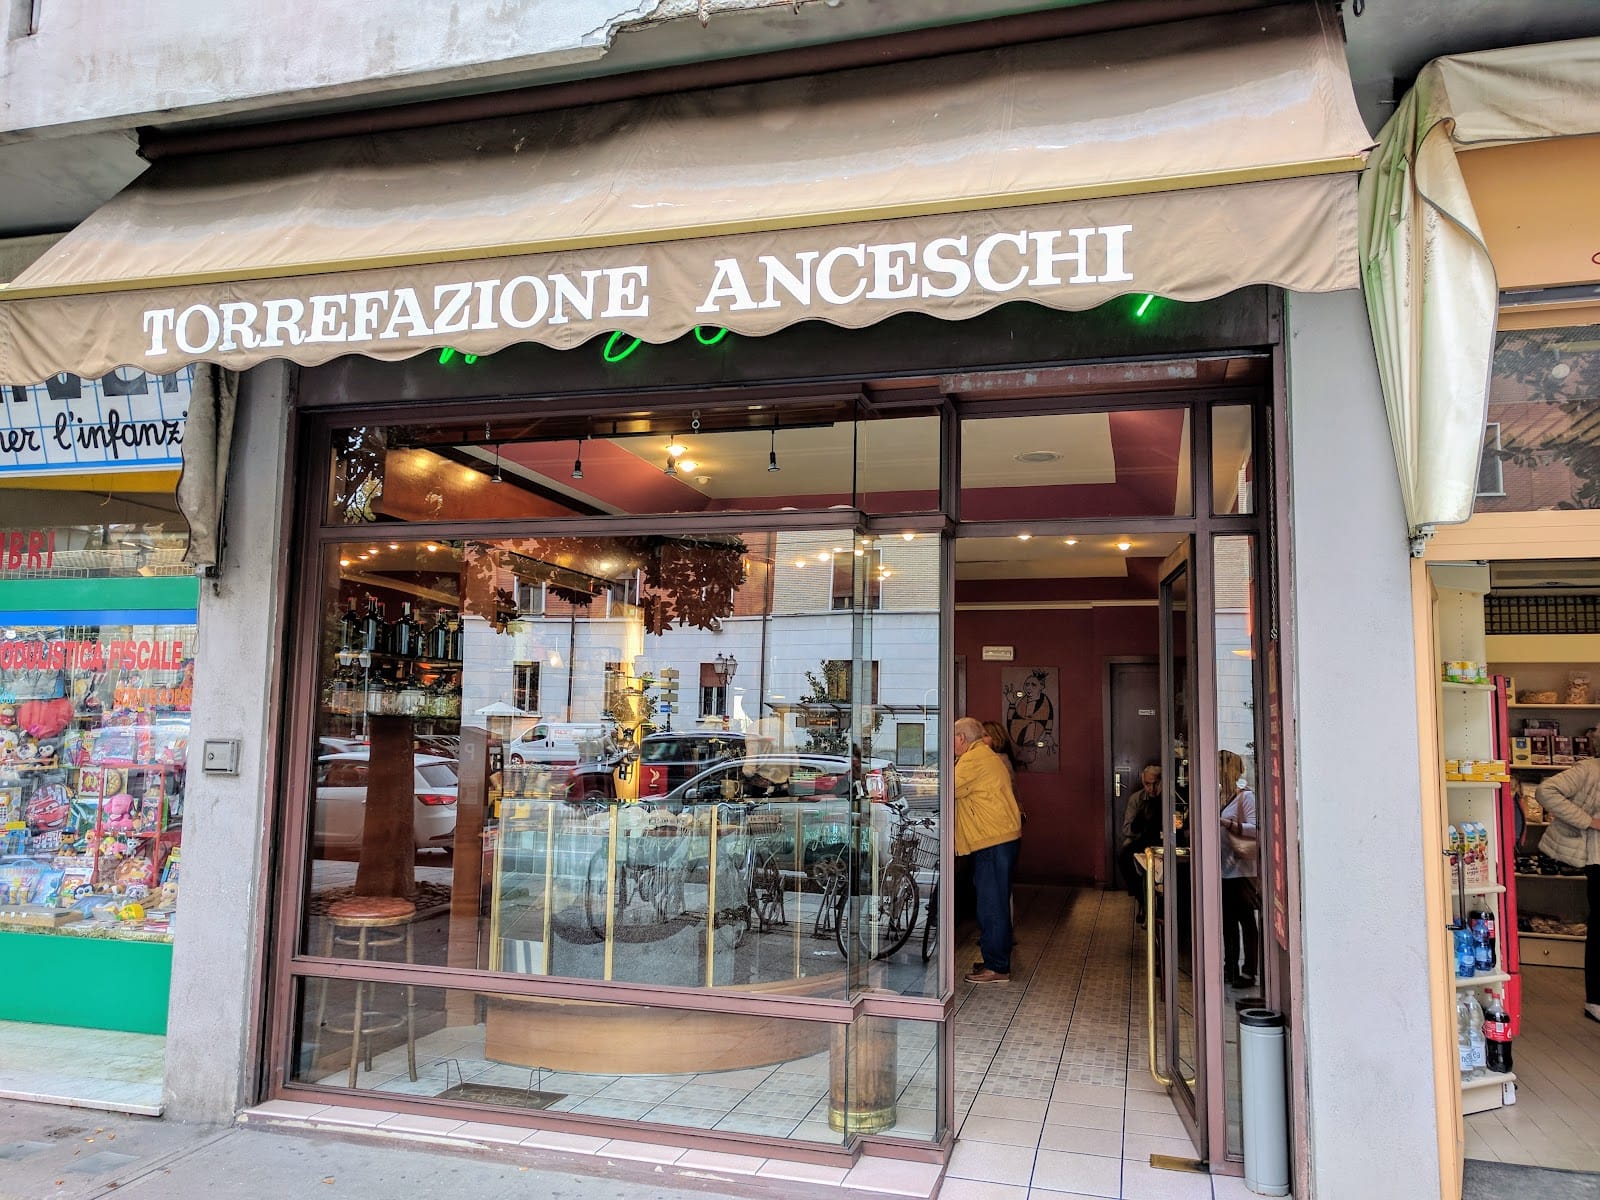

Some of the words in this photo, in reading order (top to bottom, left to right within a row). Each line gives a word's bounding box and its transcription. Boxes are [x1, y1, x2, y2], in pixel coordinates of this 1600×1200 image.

[143, 265, 649, 356] TORREFAZIONE
[695, 224, 1134, 313] ANCESCHI
[0, 640, 103, 672] ODULISTICA
[109, 640, 183, 671] FISCALE
